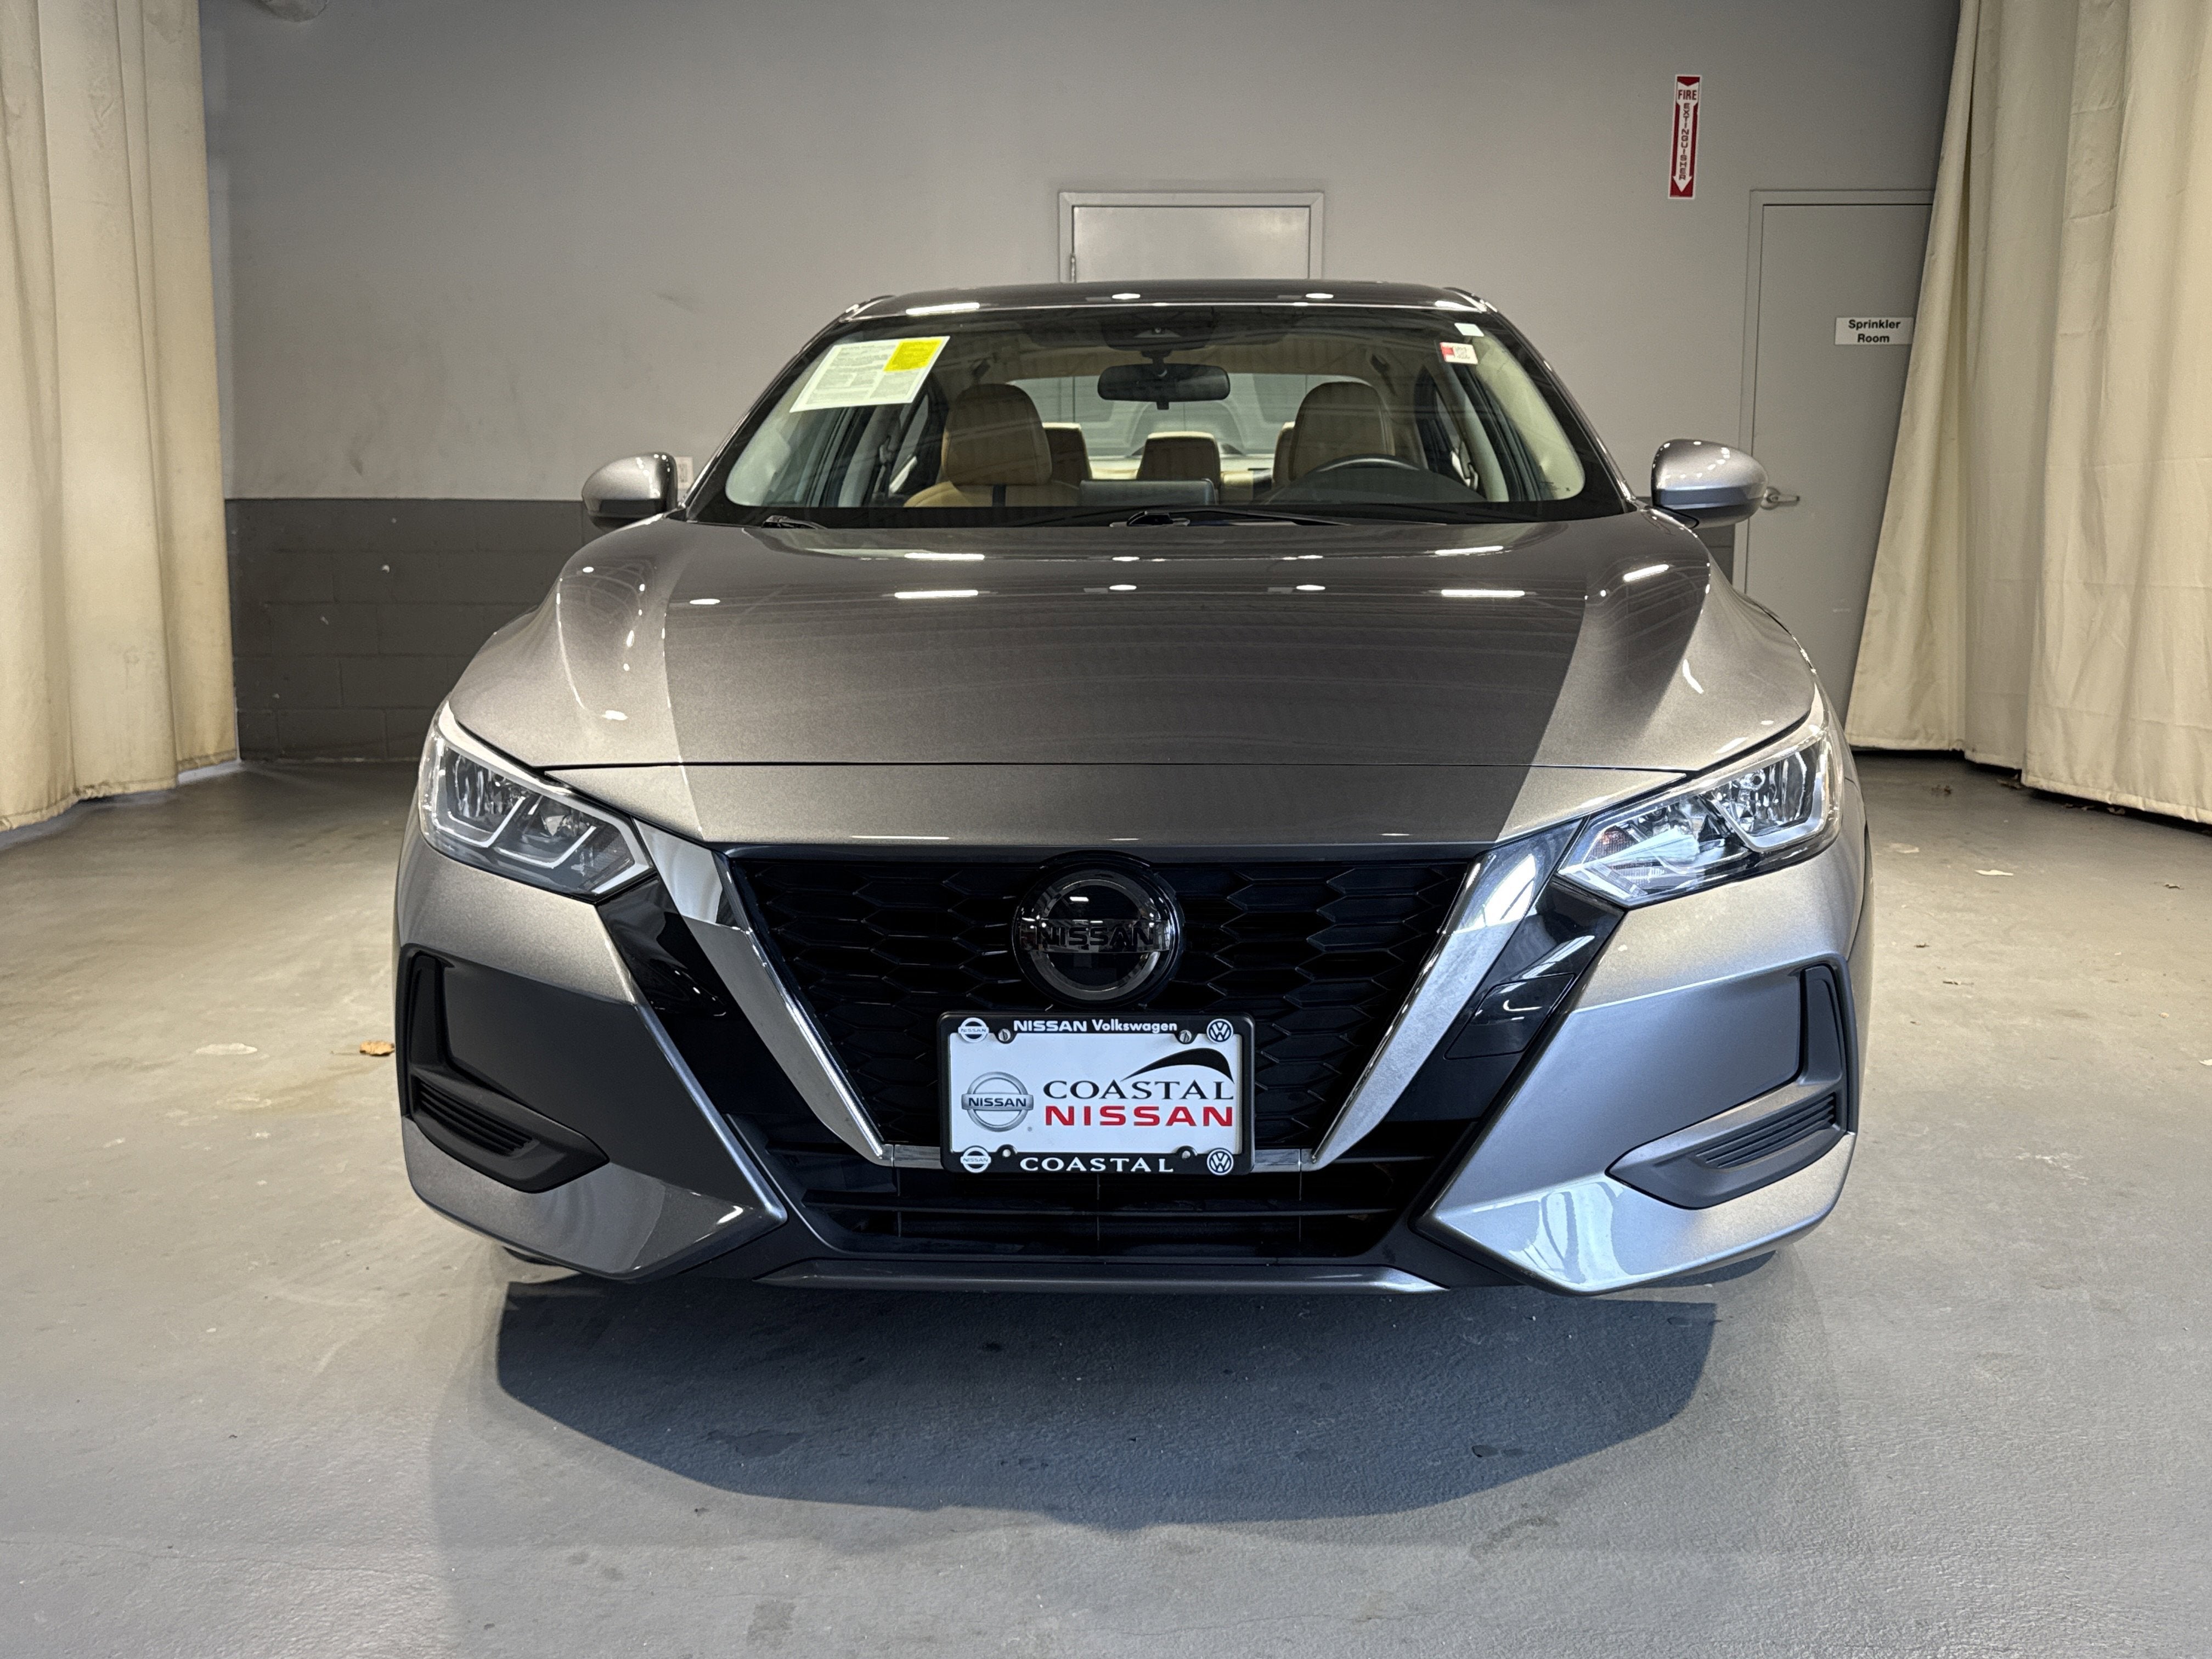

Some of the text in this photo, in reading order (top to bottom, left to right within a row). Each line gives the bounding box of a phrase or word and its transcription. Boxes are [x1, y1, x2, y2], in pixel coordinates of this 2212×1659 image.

[1678, 89, 1697, 100] FIRE
[1679, 103, 1690, 180] EXTINGUISHER
[1848, 319, 1901, 330] Sprinkler
[1857, 334, 1890, 343] Room
[1036, 926, 1154, 947] NISSAN
[1014, 1019, 1177, 1034] NISSAN Volkswagen
[1043, 1079, 1234, 1100] COASTAL
[968, 1097, 1026, 1108] NISSAN
[1045, 1105, 1233, 1126] NISSAN
[1020, 1157, 1173, 1172] COASTAL
